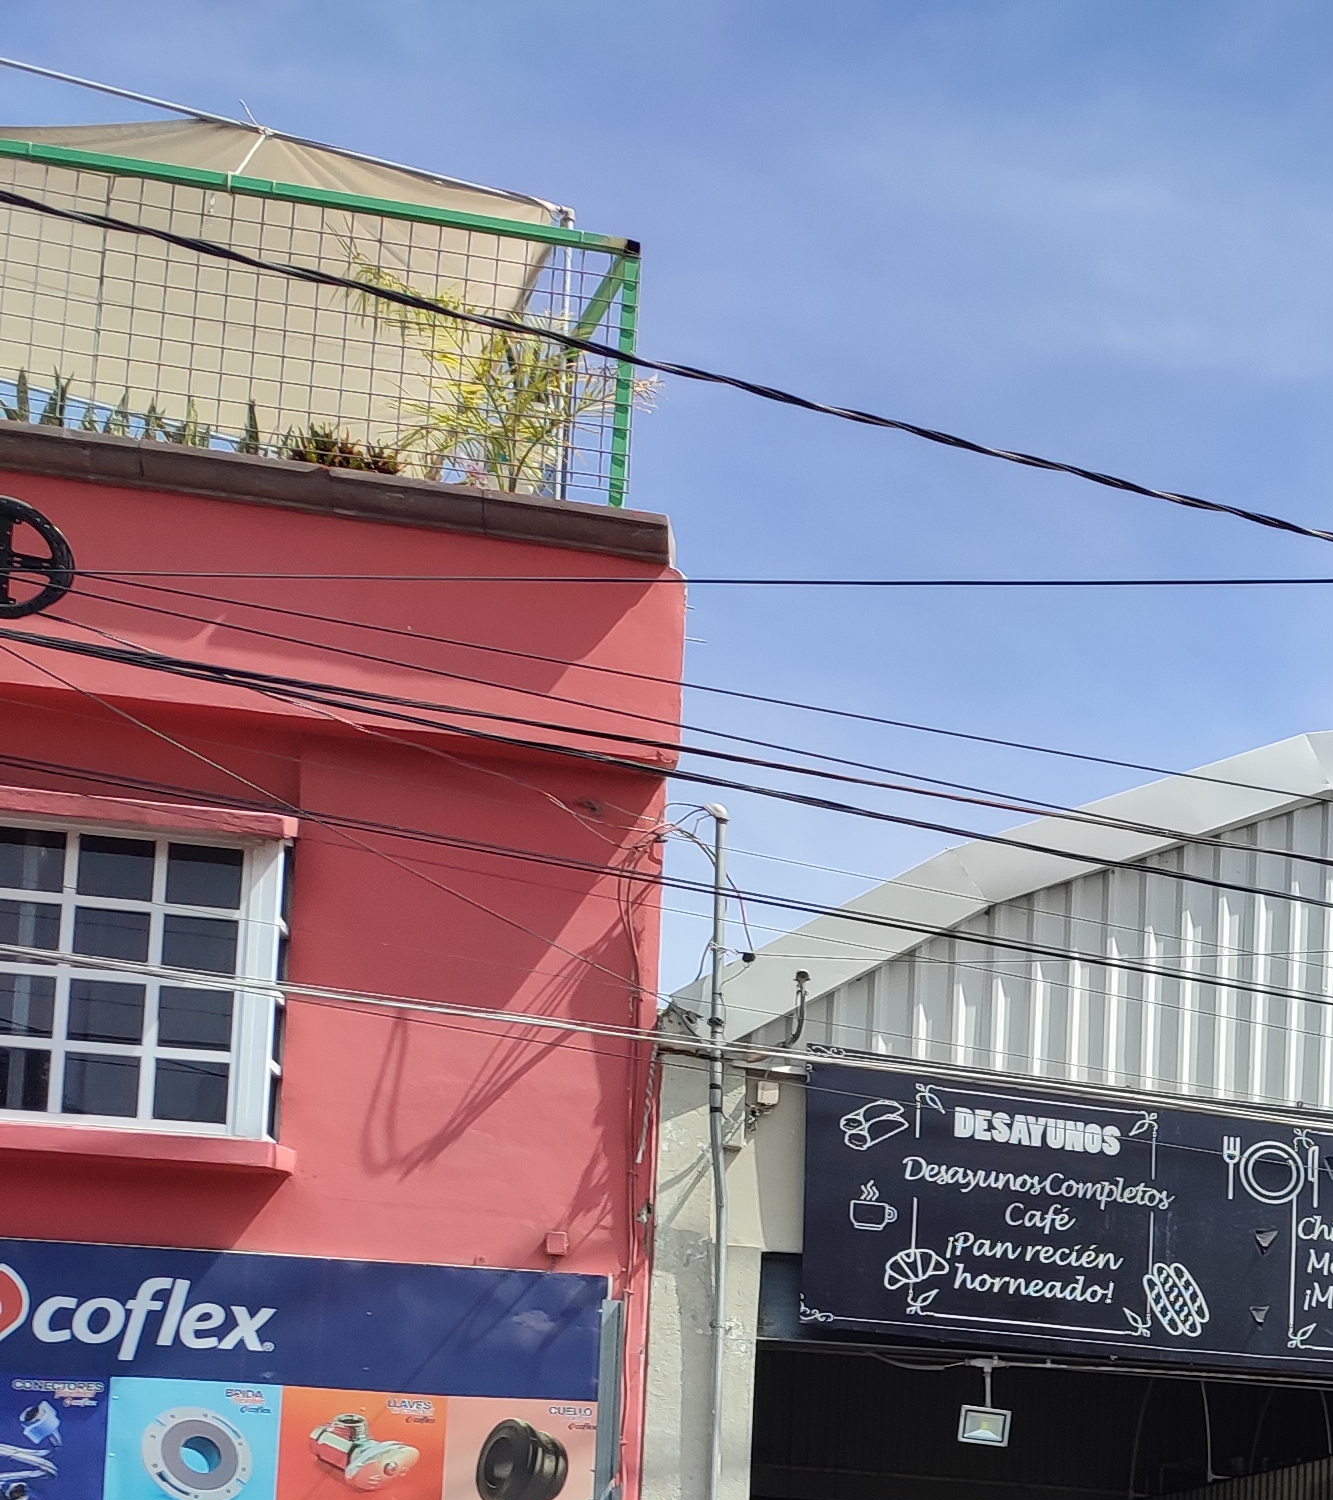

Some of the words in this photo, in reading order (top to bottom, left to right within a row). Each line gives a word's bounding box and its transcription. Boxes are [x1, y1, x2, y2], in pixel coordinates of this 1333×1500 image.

[954, 1107, 1121, 1155] DESAYUNOS
[1005, 1202, 1076, 1234] Café
[1026, 1243, 1124, 1270] recién
[953, 1263, 1115, 1304] horneado!
[32, 1277, 278, 1361] coflex
[12, 1379, 104, 1393] CONECTORES
[387, 1399, 432, 1410] LLAVES
[548, 1406, 592, 1417] CUELLO
